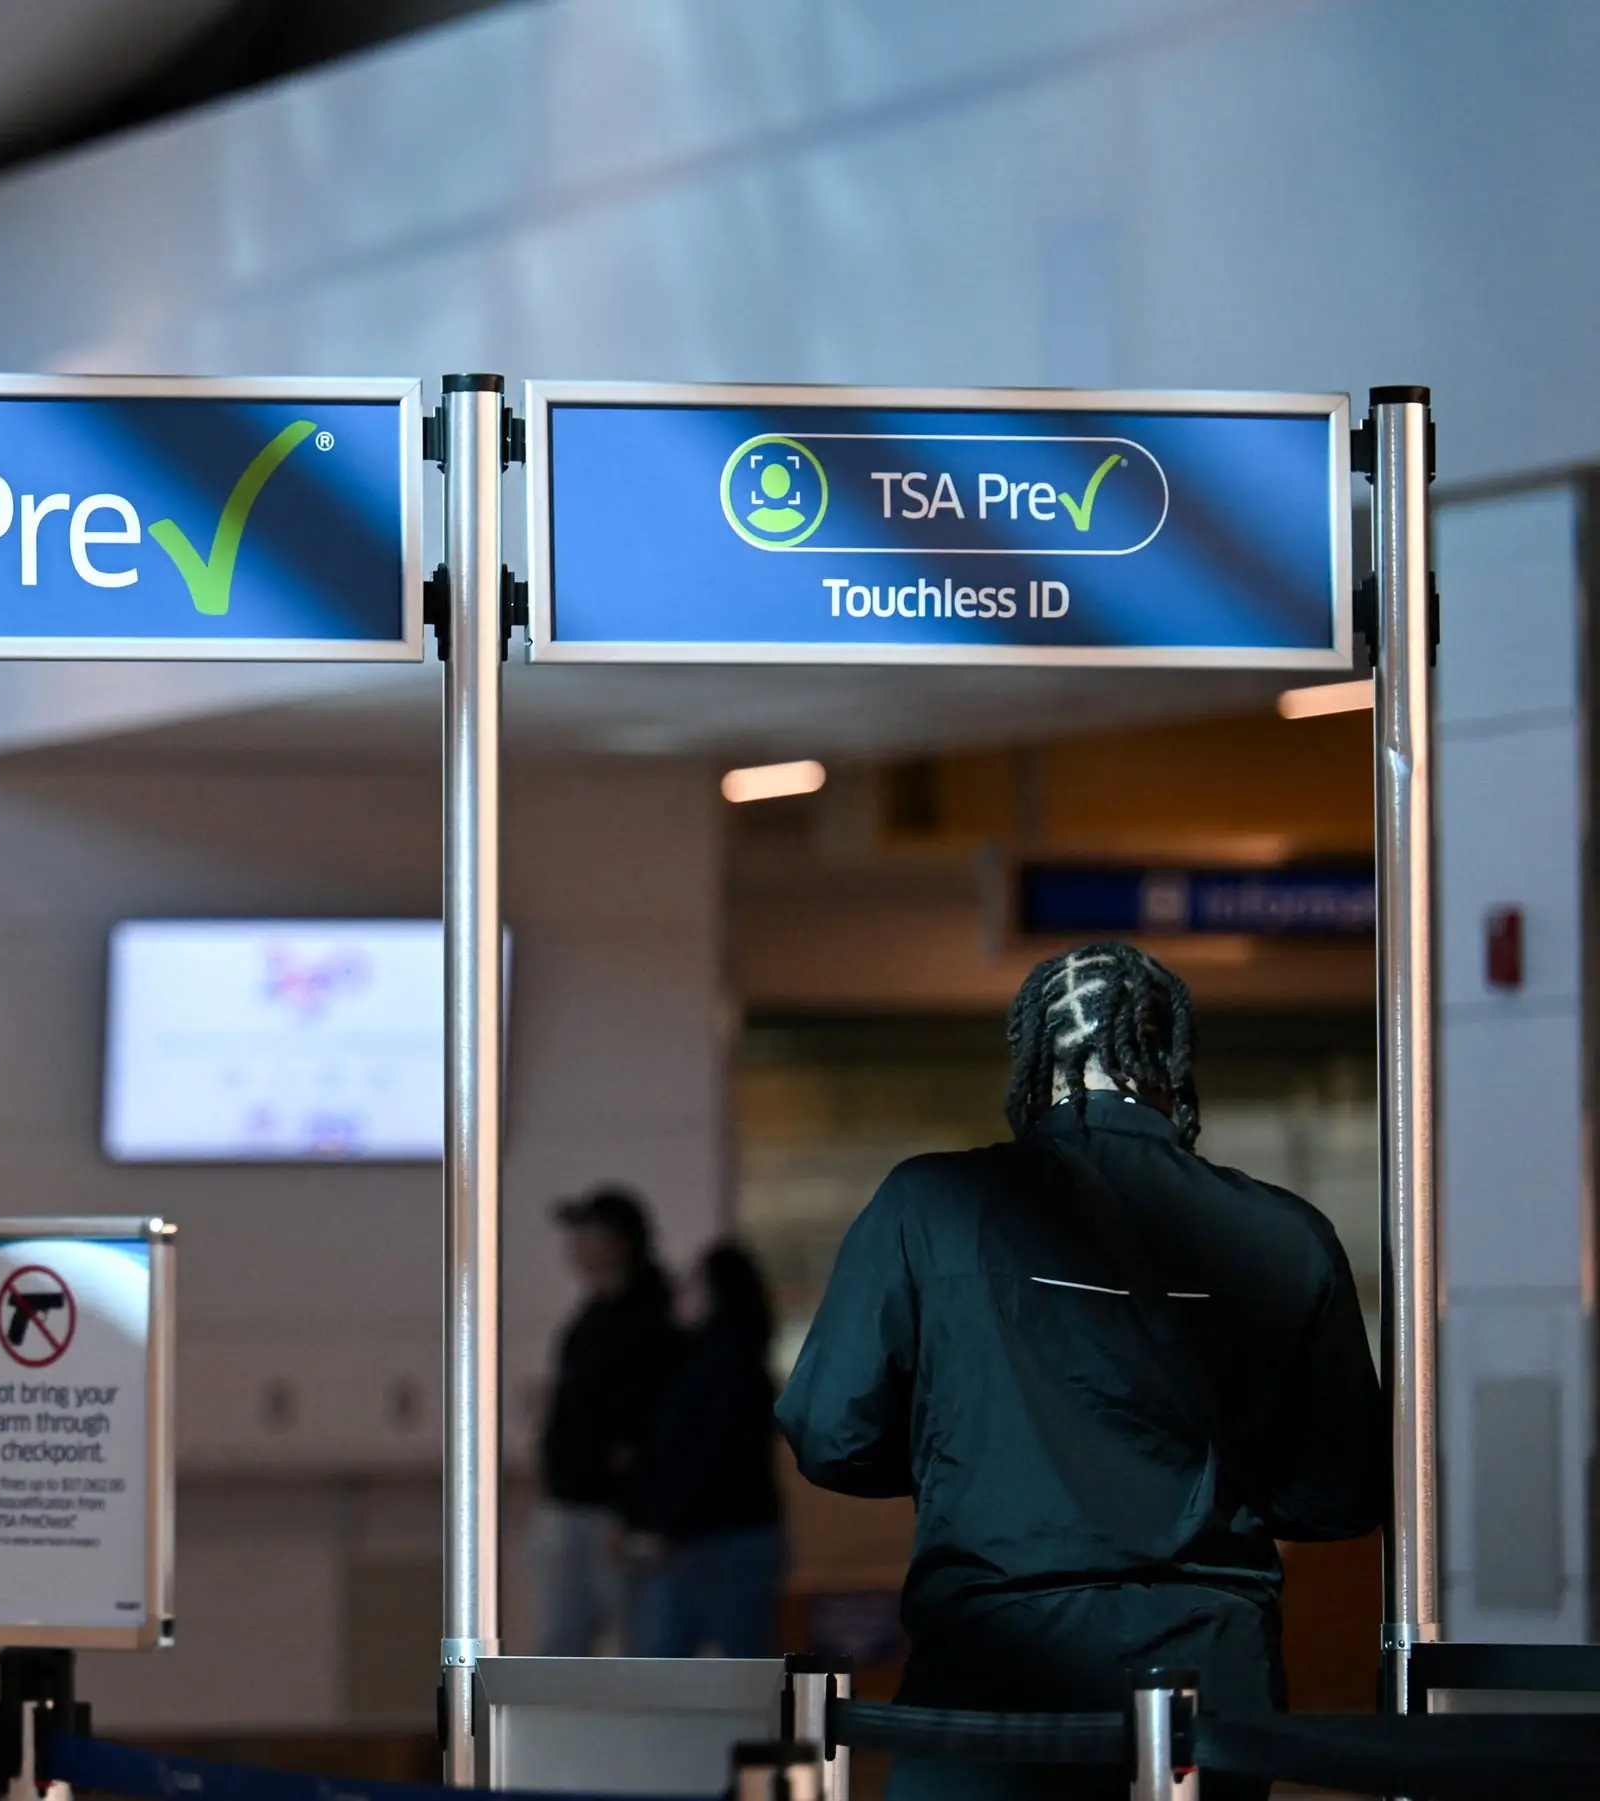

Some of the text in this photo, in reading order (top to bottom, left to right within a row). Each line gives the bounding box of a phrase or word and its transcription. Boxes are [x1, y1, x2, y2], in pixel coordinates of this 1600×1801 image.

[870, 471, 965, 520] TSA
[821, 578, 1070, 619] Touchless ID
[21, 1381, 69, 1409] bring
[74, 1384, 119, 1408] your
[36, 1412, 110, 1438] through
[1, 1440, 106, 1466] checkpoint.
